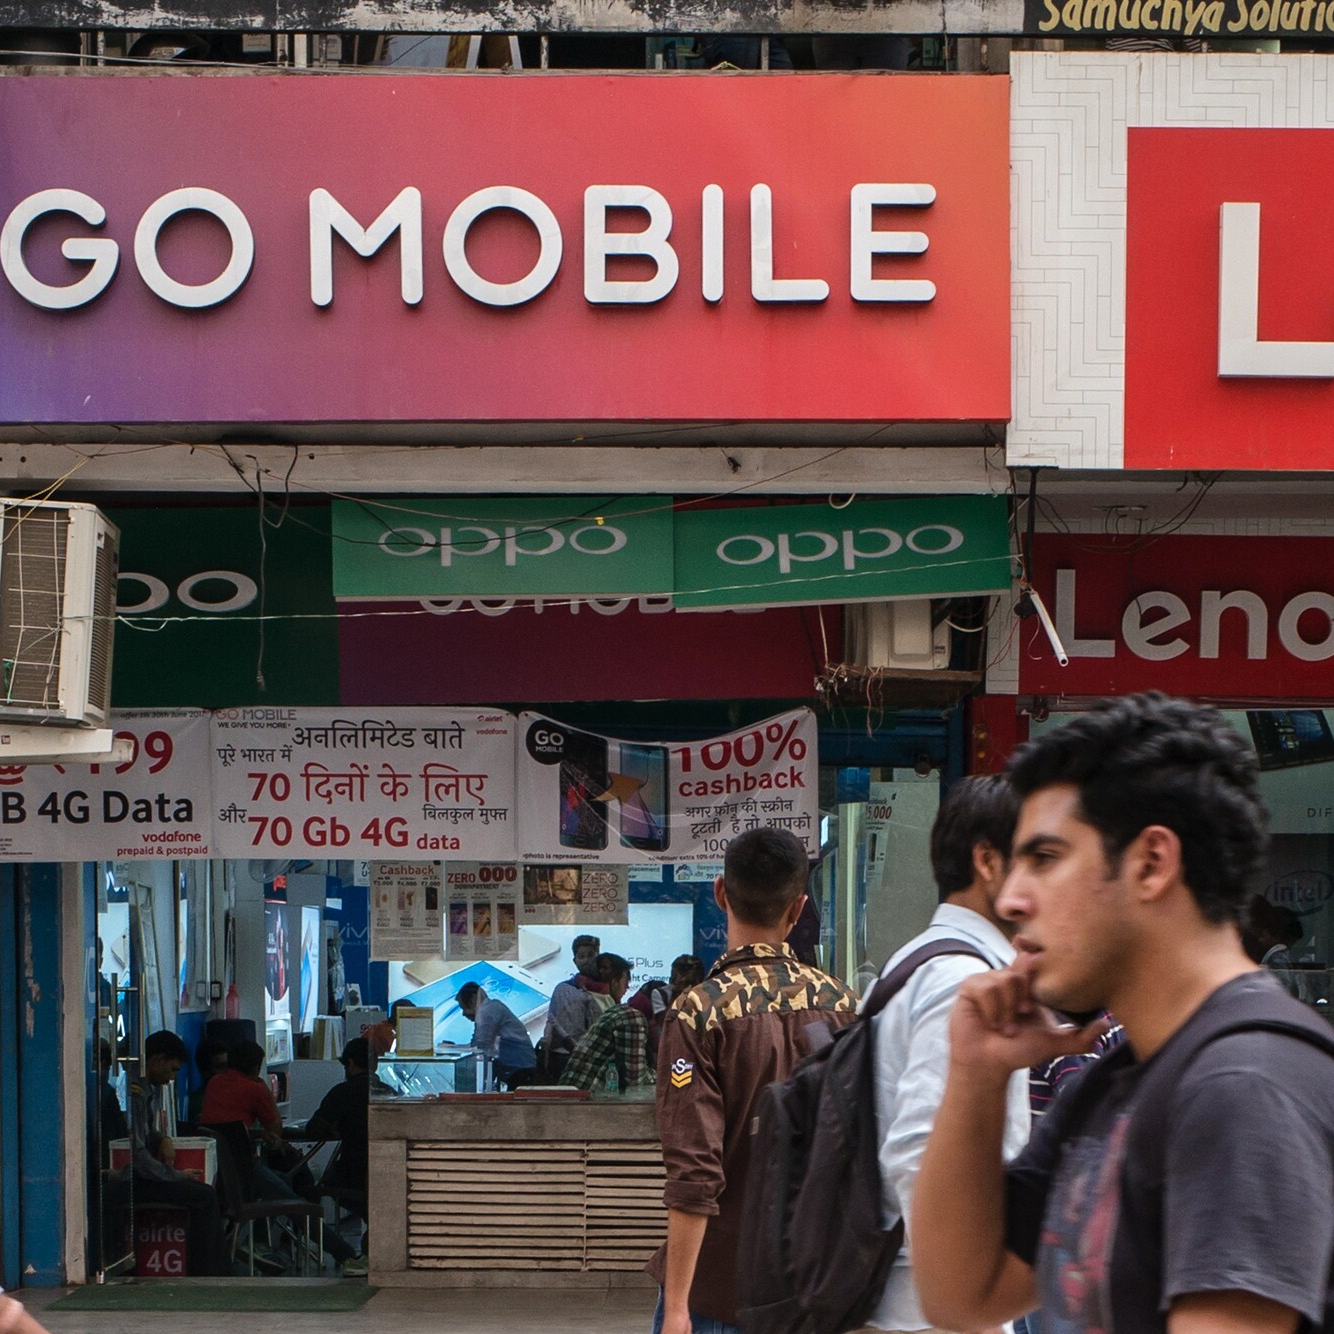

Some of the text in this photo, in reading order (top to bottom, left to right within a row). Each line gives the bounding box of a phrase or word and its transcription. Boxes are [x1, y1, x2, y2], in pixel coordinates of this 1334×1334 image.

[0, 182, 937, 309] GO MOBILE
[378, 525, 627, 567] oppo
[717, 524, 964, 574] oppo
[120, 711, 139, 720] offer
[171, 710, 187, 718] June
[216, 708, 297, 720] GO MOBILE
[291, 719, 417, 749] अनलिमिटेड
[476, 727, 508, 735] vodafone
[535, 730, 564, 746] GO
[217, 744, 294, 767] पूरे भारत में
[535, 745, 564, 753] MOBILE
[670, 719, 807, 773] 100%
[247, 761, 489, 806] 70 दिनों के लिए
[678, 766, 806, 797] cashback
[37, 790, 91, 825] 4G
[102, 790, 194, 824] Data
[217, 803, 247, 823] और
[684, 806, 712, 819] अगर
[741, 798, 758, 814] की
[142, 830, 202, 843] vodafone
[247, 816, 460, 850] 70 Gb 4G data
[690, 818, 723, 840] टूटती
[730, 814, 741, 834] है
[744, 814, 760, 830] तो
[117, 845, 208, 857] prepaid & postpaid
[553, 852, 600, 861] representative
[379, 865, 435, 876] Cashback
[447, 872, 476, 884] ZERO
[583, 873, 618, 884] ZERO
[583, 888, 618, 899] ZERO
[583, 902, 616, 913] ZERO
[146, 1249, 183, 1274] 4G
